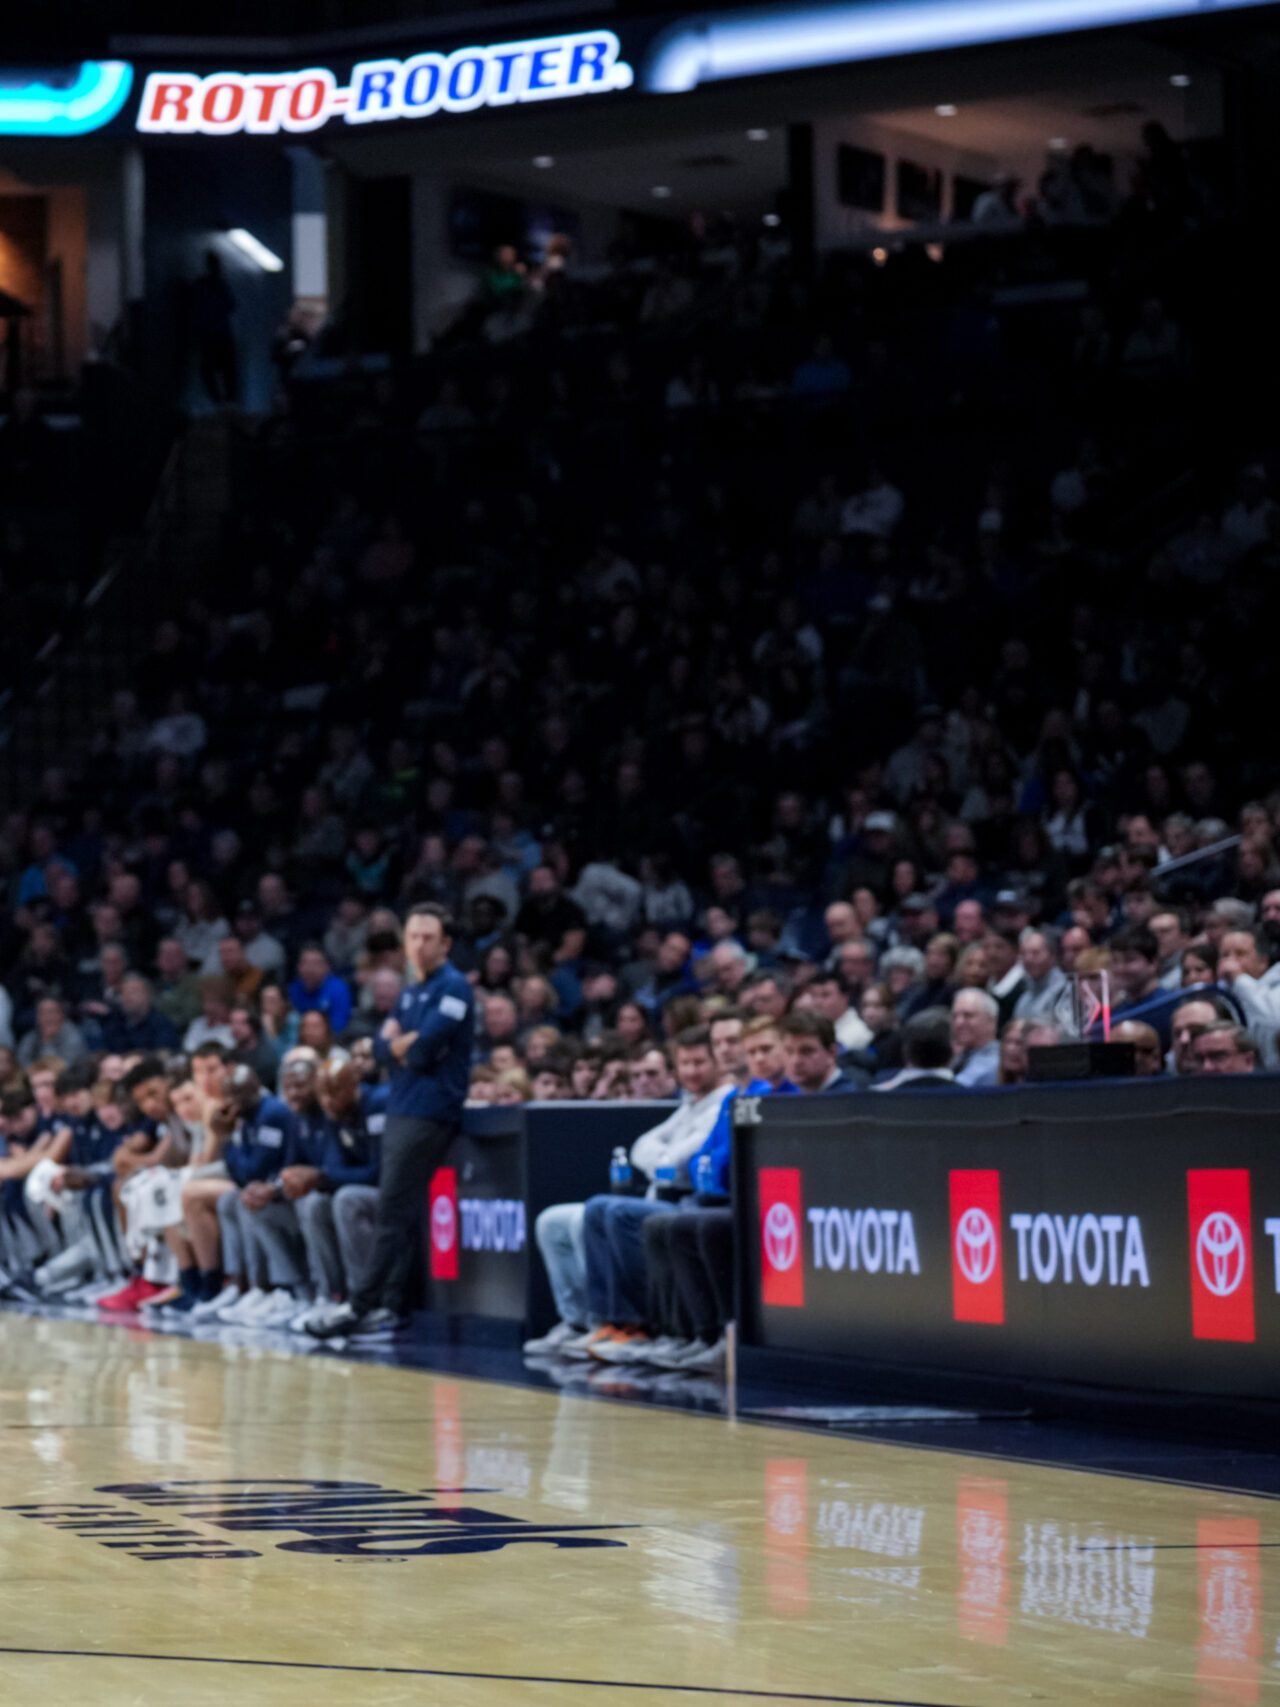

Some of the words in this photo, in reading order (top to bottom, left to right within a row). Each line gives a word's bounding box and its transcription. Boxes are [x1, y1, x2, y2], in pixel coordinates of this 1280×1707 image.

[459, 1198, 527, 1252] TOYOTA
[808, 1206, 920, 1275] TOYOTA
[1010, 1212, 1150, 1288] TOYOTA
